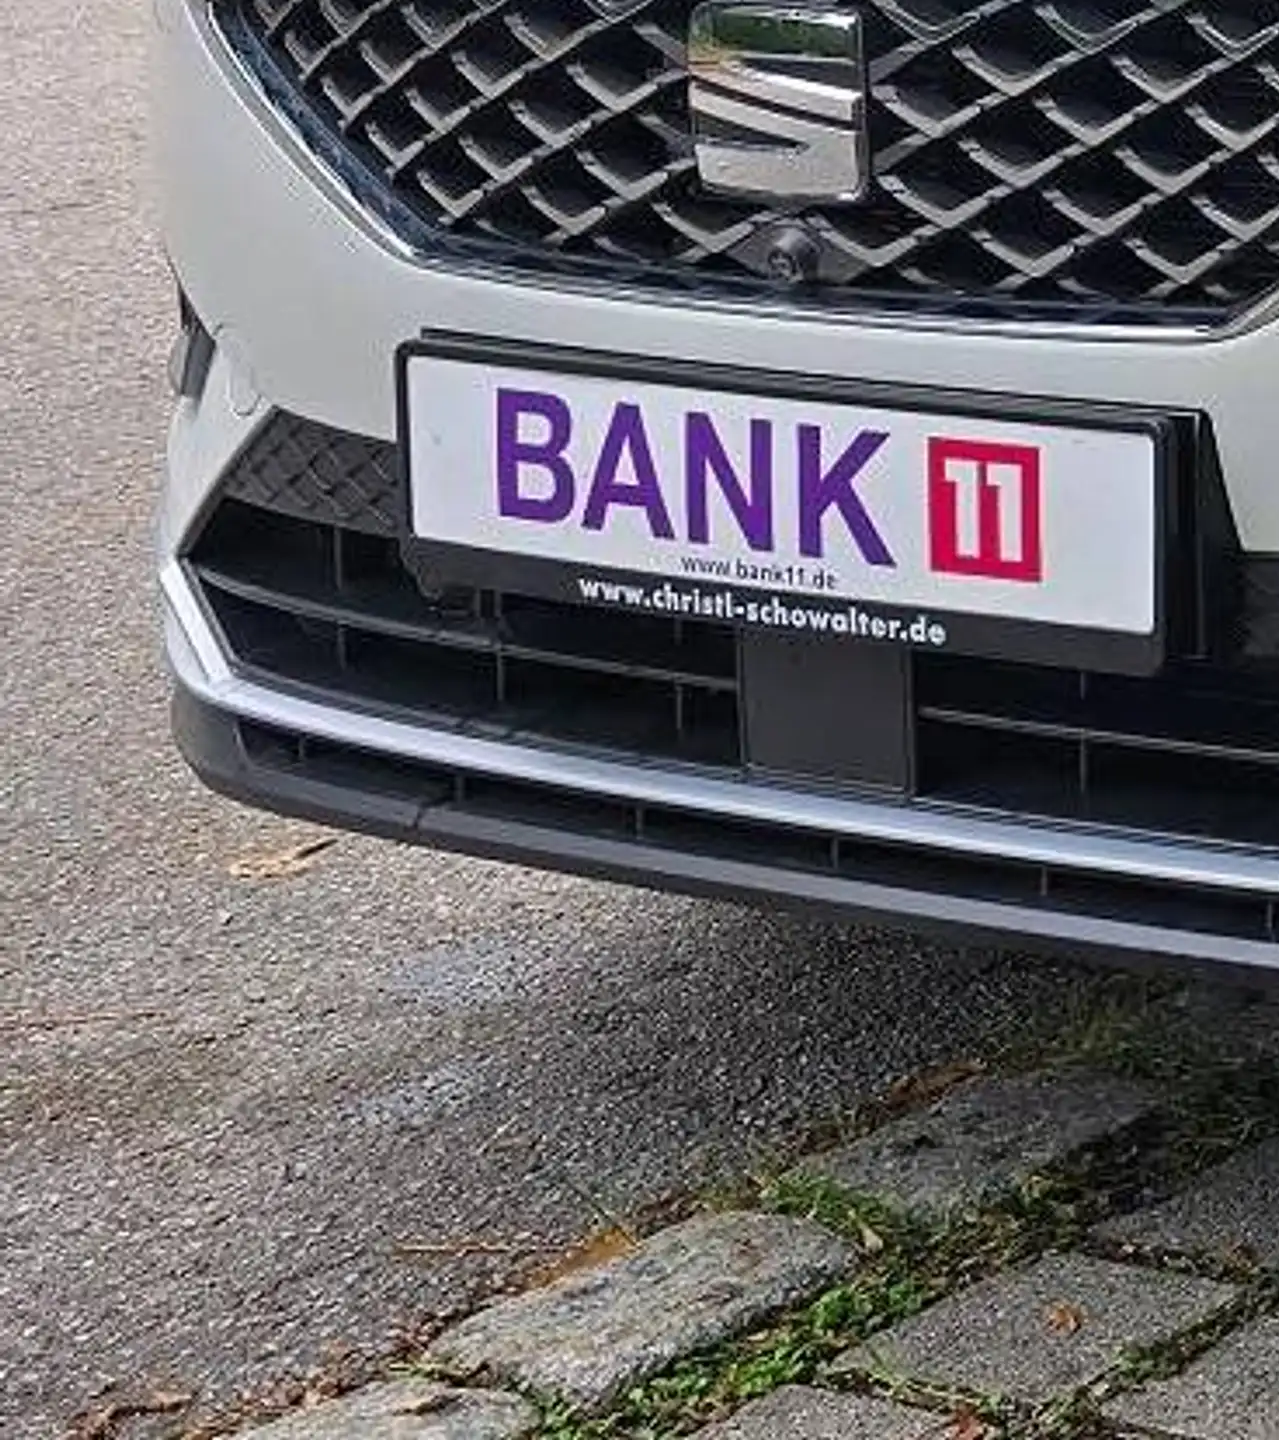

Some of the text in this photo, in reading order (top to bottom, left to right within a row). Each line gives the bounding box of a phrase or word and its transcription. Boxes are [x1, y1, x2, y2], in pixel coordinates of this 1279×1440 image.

[496, 387, 1027, 568] BANK 11
[680, 556, 838, 591] www.bank11.de
[577, 576, 947, 645] www.christl-schowalter.de
